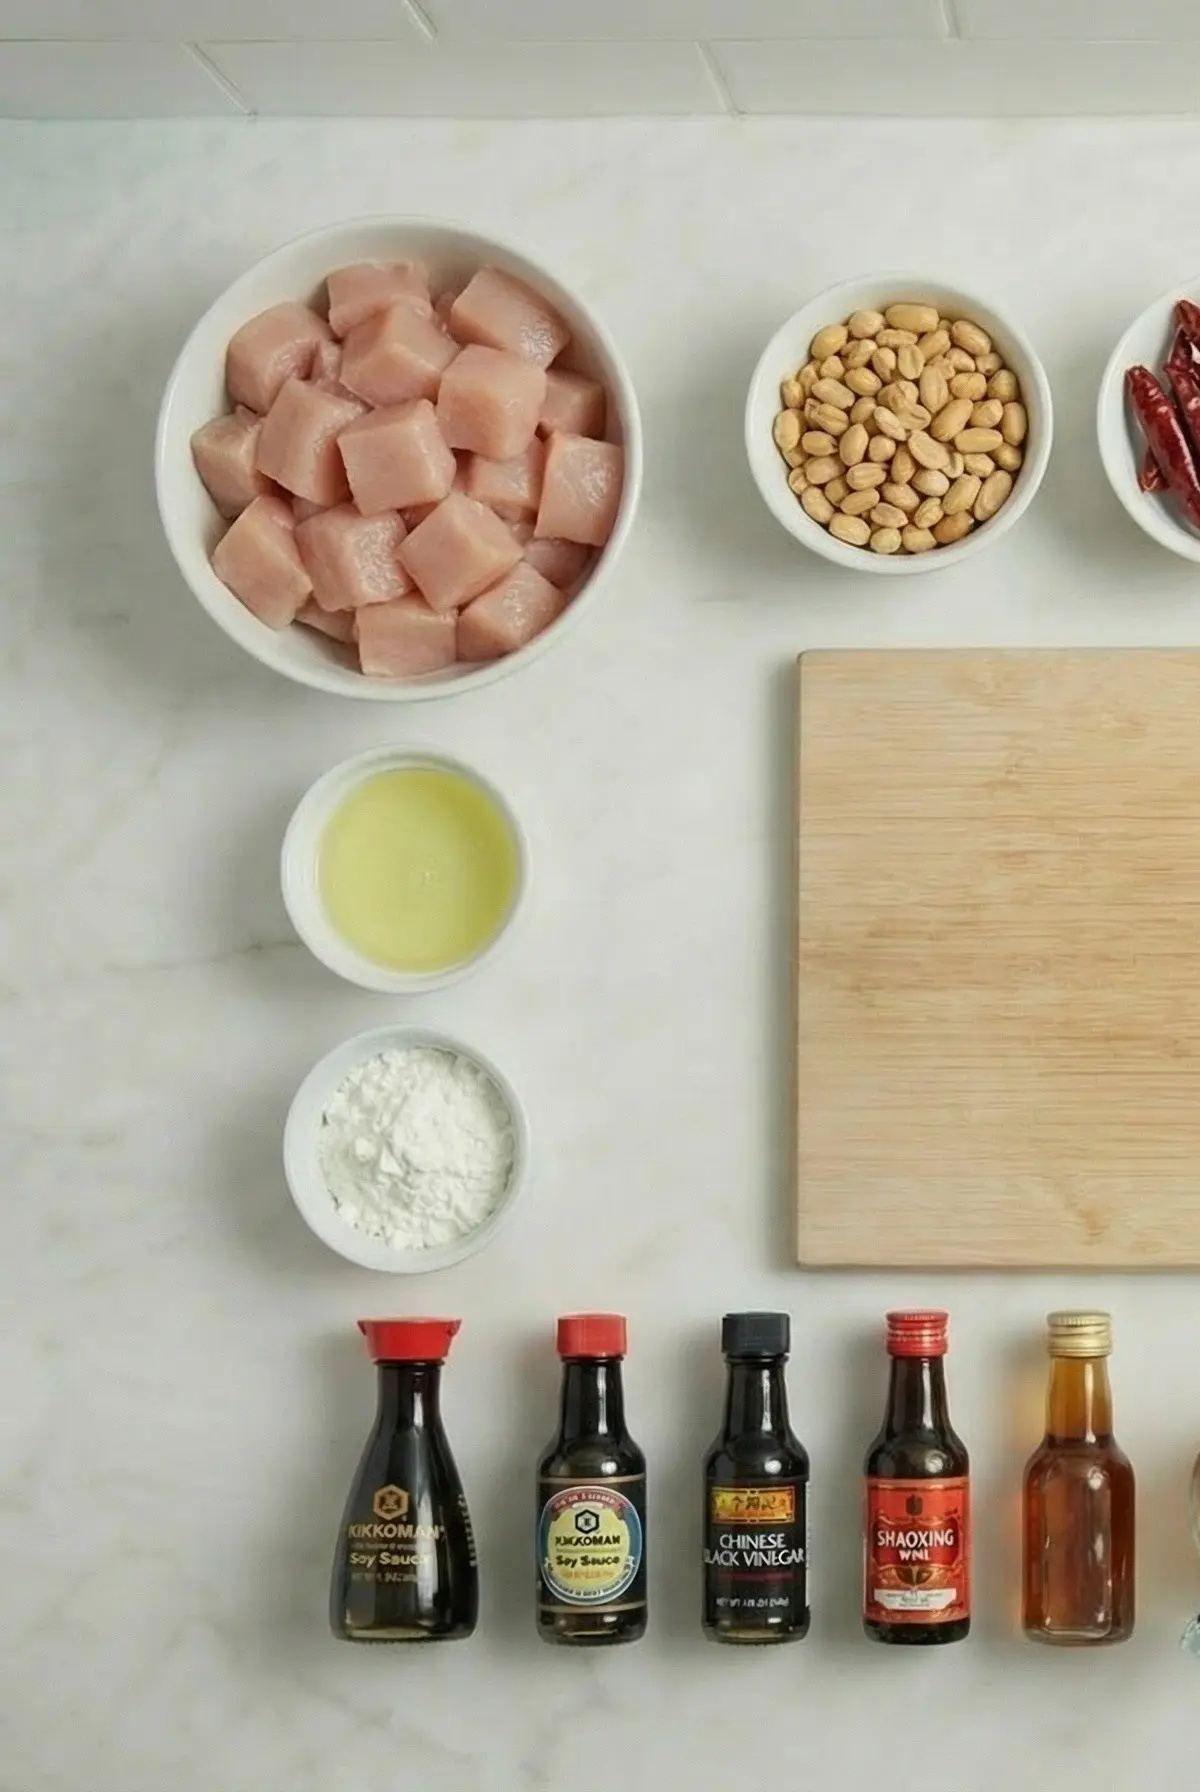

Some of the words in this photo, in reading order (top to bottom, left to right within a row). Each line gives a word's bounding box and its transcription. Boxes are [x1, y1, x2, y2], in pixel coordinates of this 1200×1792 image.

[348, 1523, 439, 1539] KIKKOMAN
[877, 1529, 954, 1548] SHAOXING
[720, 1533, 787, 1549] CHINESE
[350, 1552, 377, 1568] Soy
[743, 1548, 804, 1567] VINEGAR
